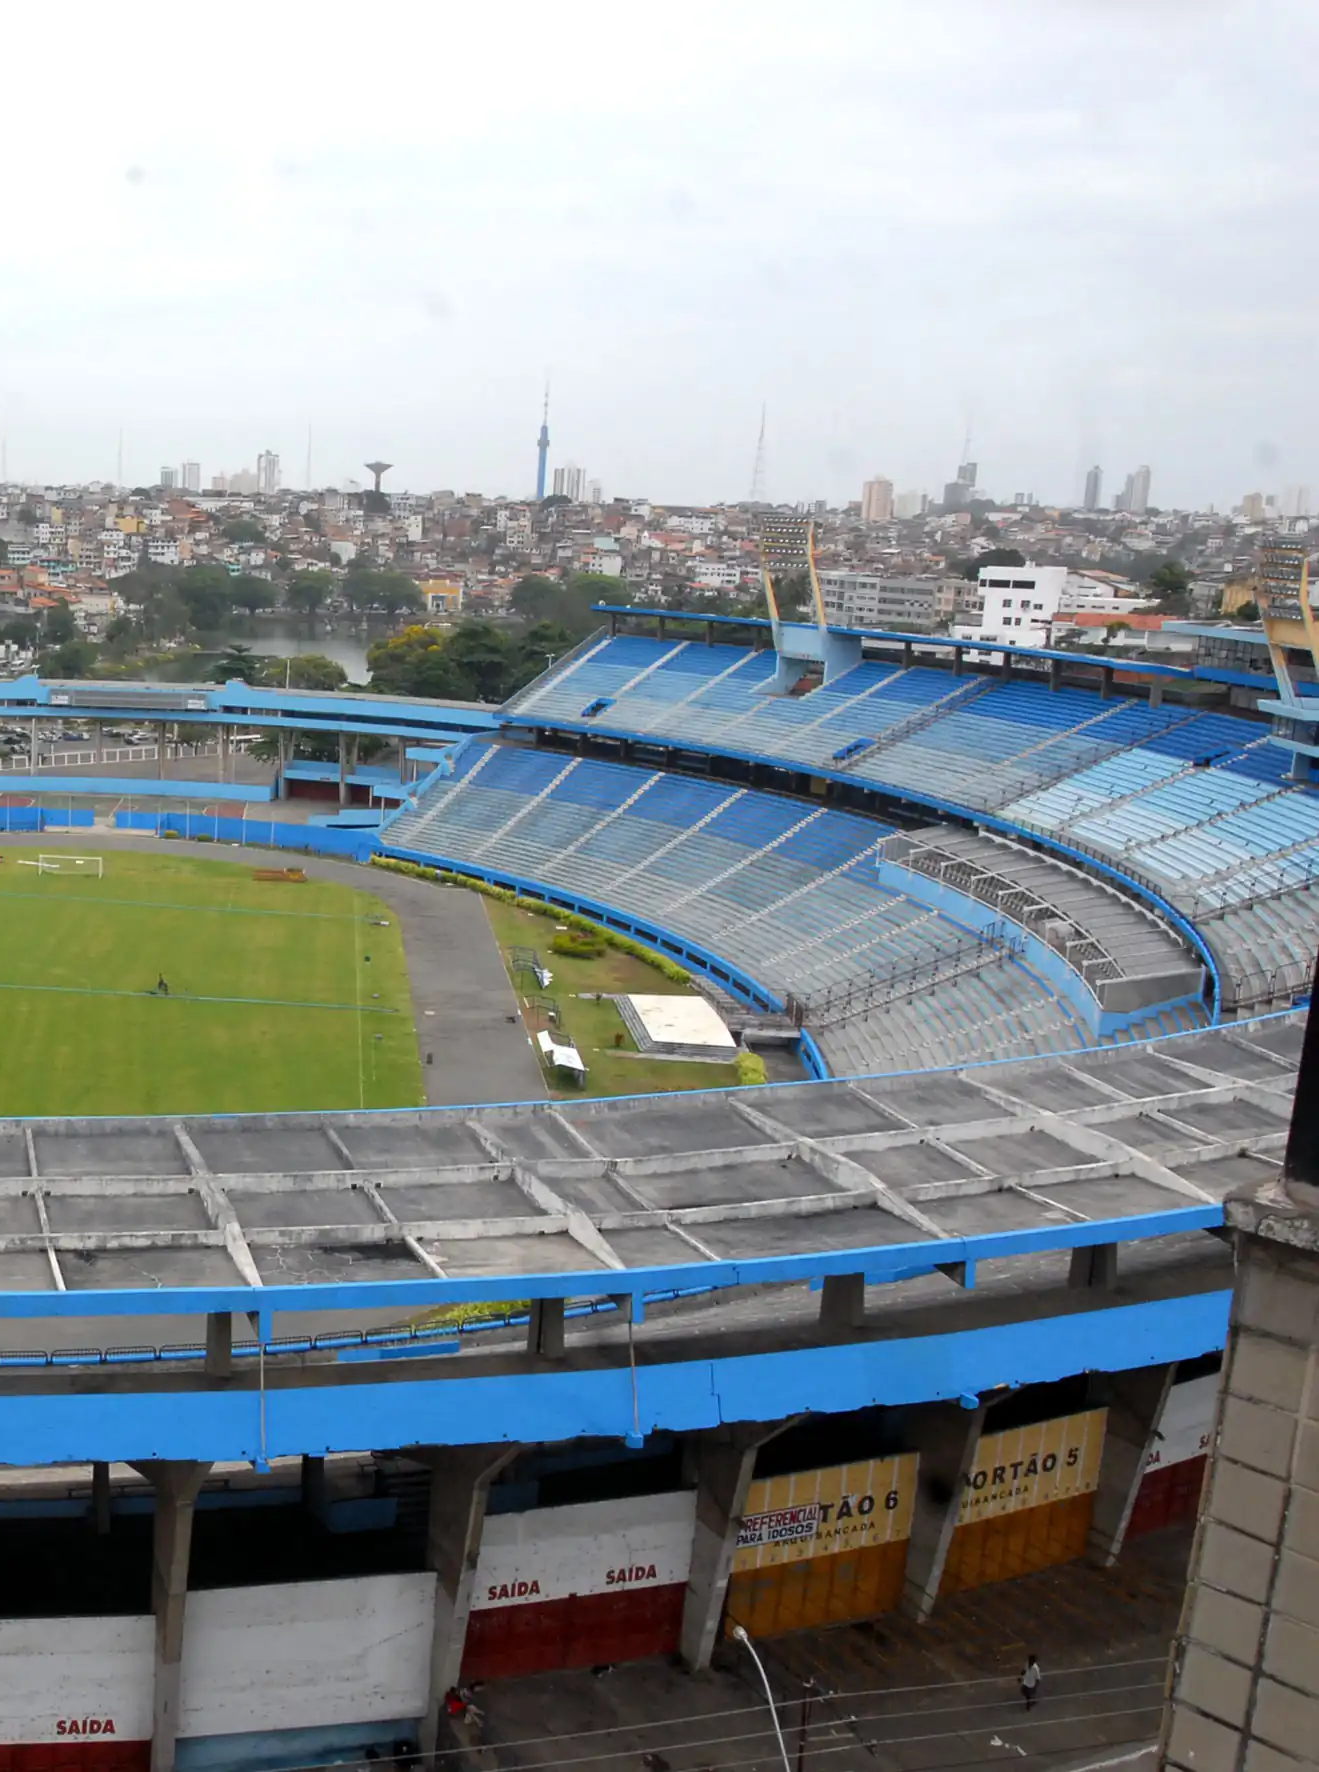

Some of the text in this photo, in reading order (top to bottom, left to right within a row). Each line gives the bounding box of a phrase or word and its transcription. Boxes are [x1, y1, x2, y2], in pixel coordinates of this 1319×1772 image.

[970, 1448, 1079, 1490] ORTÃO 5
[819, 1490, 898, 1523] TÃO 6
[744, 1505, 817, 1533] REFERENCIAL
[736, 1522, 814, 1546] PARA IDOSOS
[606, 1564, 657, 1585] SAÍDA
[488, 1579, 541, 1601] SAÍDA
[56, 1716, 116, 1735] SAÍDA
